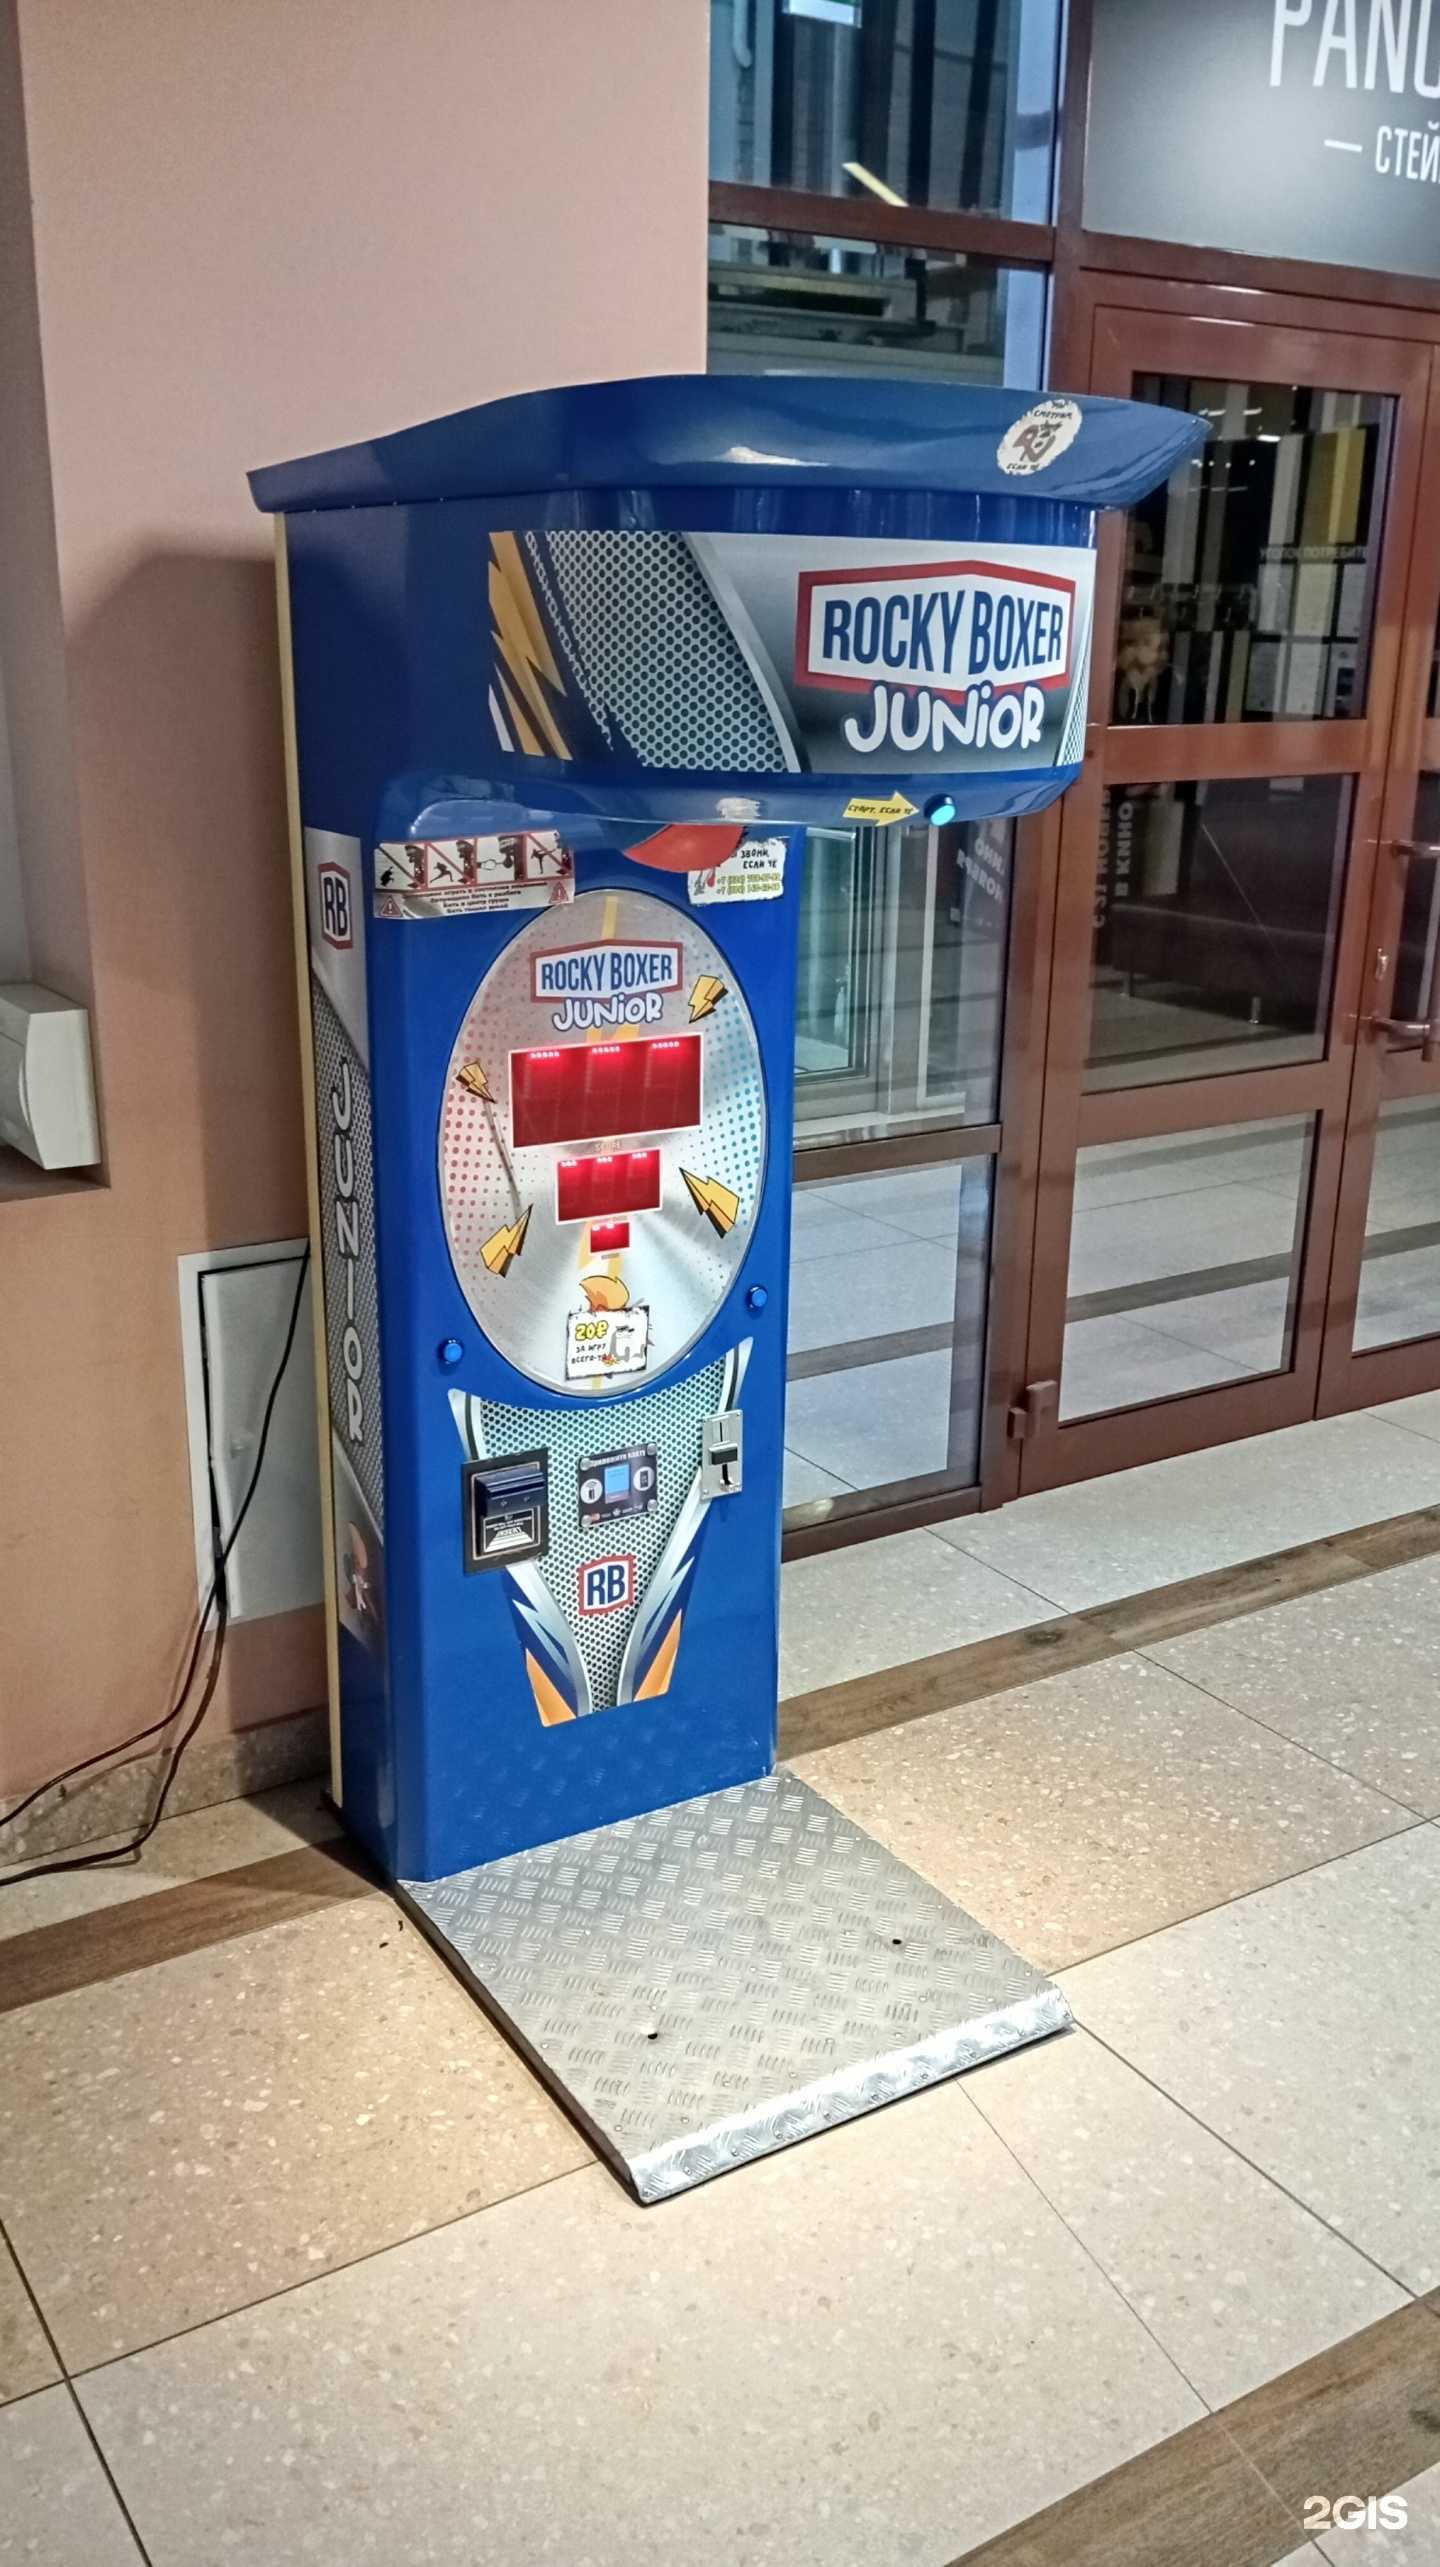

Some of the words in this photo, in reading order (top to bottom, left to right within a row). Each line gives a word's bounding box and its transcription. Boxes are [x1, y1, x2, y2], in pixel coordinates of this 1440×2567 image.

[822, 590, 966, 674] ROCKY
[968, 590, 1064, 675] BOXER
[323, 876, 348, 937] RB
[541, 953, 606, 991] ROCKY
[611, 953, 673, 990] BOXER
[332, 1062, 365, 1443] JUNIOR
[587, 1564, 626, 1606] RB
